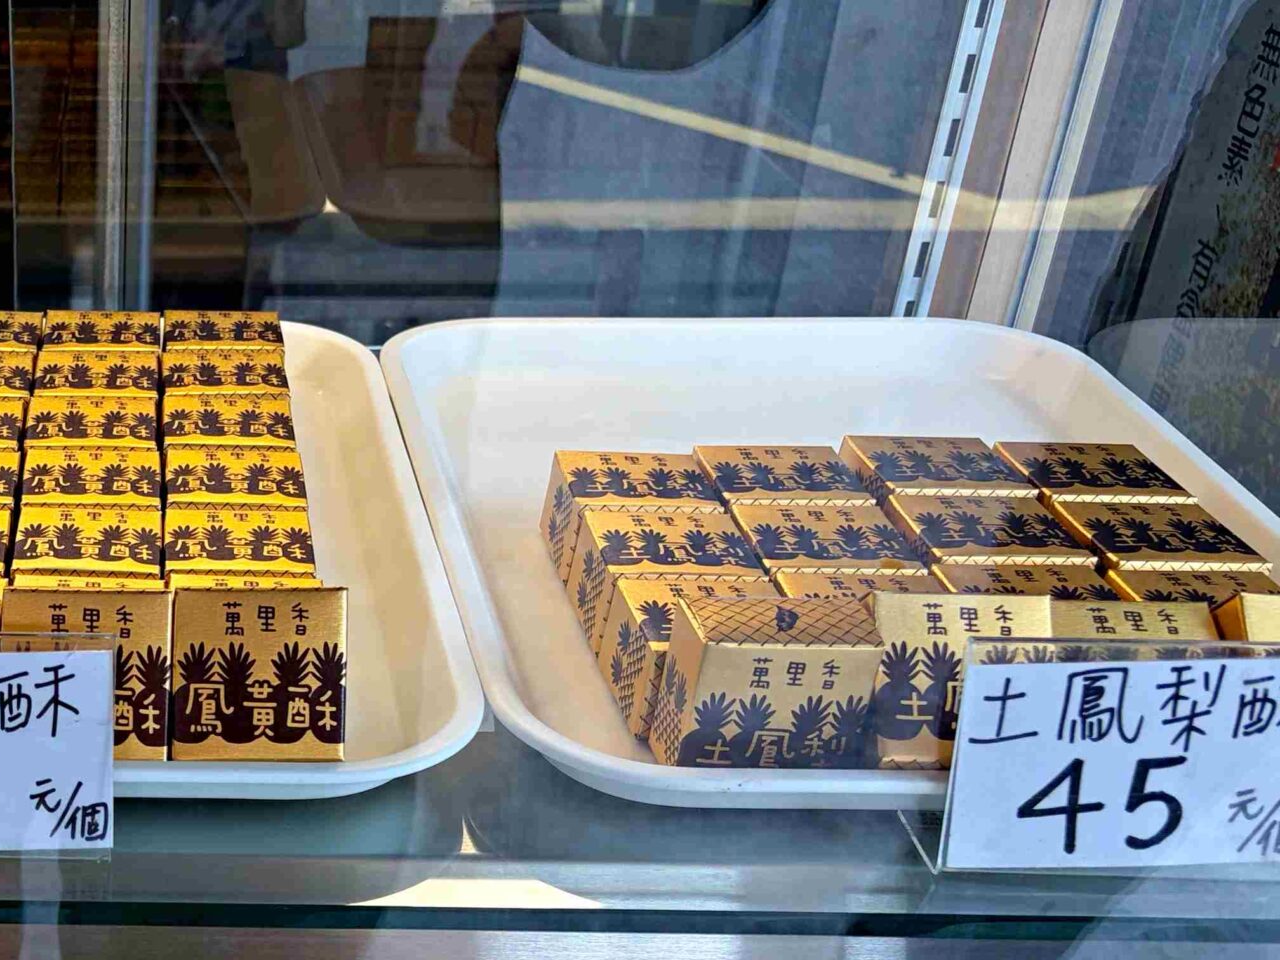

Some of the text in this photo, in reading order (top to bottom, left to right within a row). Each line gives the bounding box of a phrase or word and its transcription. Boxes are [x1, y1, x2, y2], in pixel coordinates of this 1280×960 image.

[23, 537, 155, 560] 鳳黃酥
[169, 537, 308, 560] 鳳黃酥
[222, 602, 310, 636] 萬里香
[924, 602, 1014, 637] 萬里香
[1086, 607, 1180, 636] 萬里香
[749, 657, 841, 690] 萬里香
[185, 680, 338, 736] 鳳黃酥
[29, 777, 109, 842] 元/個
[1017, 755, 1187, 854] 45
